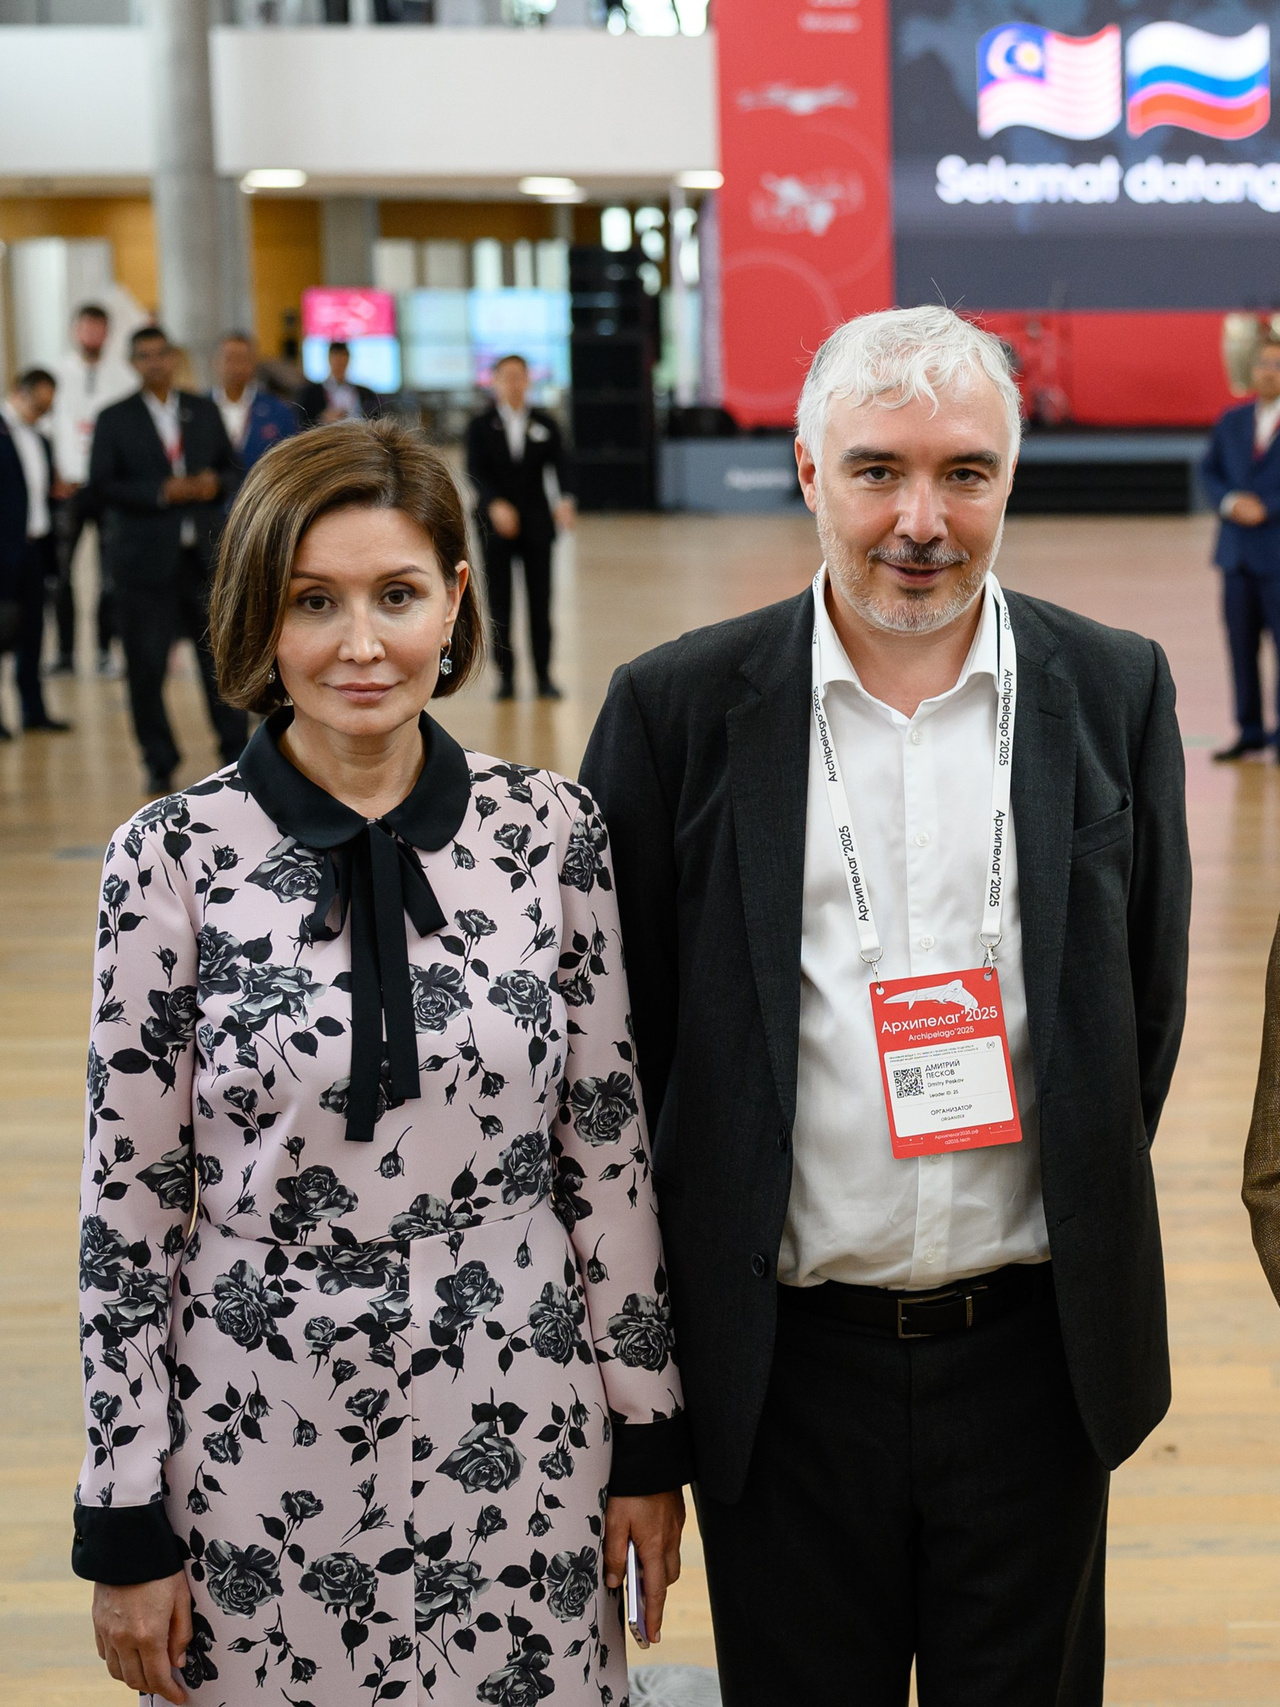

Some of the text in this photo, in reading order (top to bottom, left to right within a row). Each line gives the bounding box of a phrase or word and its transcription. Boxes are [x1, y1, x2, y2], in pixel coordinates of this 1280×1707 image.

[936, 154, 1121, 204] Selamat
[998, 668, 1013, 766] Archipelago'2025
[989, 809, 1006, 907] Архипелаг'2025
[838, 825, 870, 922] Архипелаг'2025
[881, 1005, 998, 1035] Архипелаг'2025
[908, 1025, 975, 1042] Archipelago'2025
[925, 1058, 961, 1072] ДМИТРИЙ
[926, 1069, 955, 1079] ПЕСКОВ
[930, 1104, 973, 1116] ОРГАНИЗАТОР
